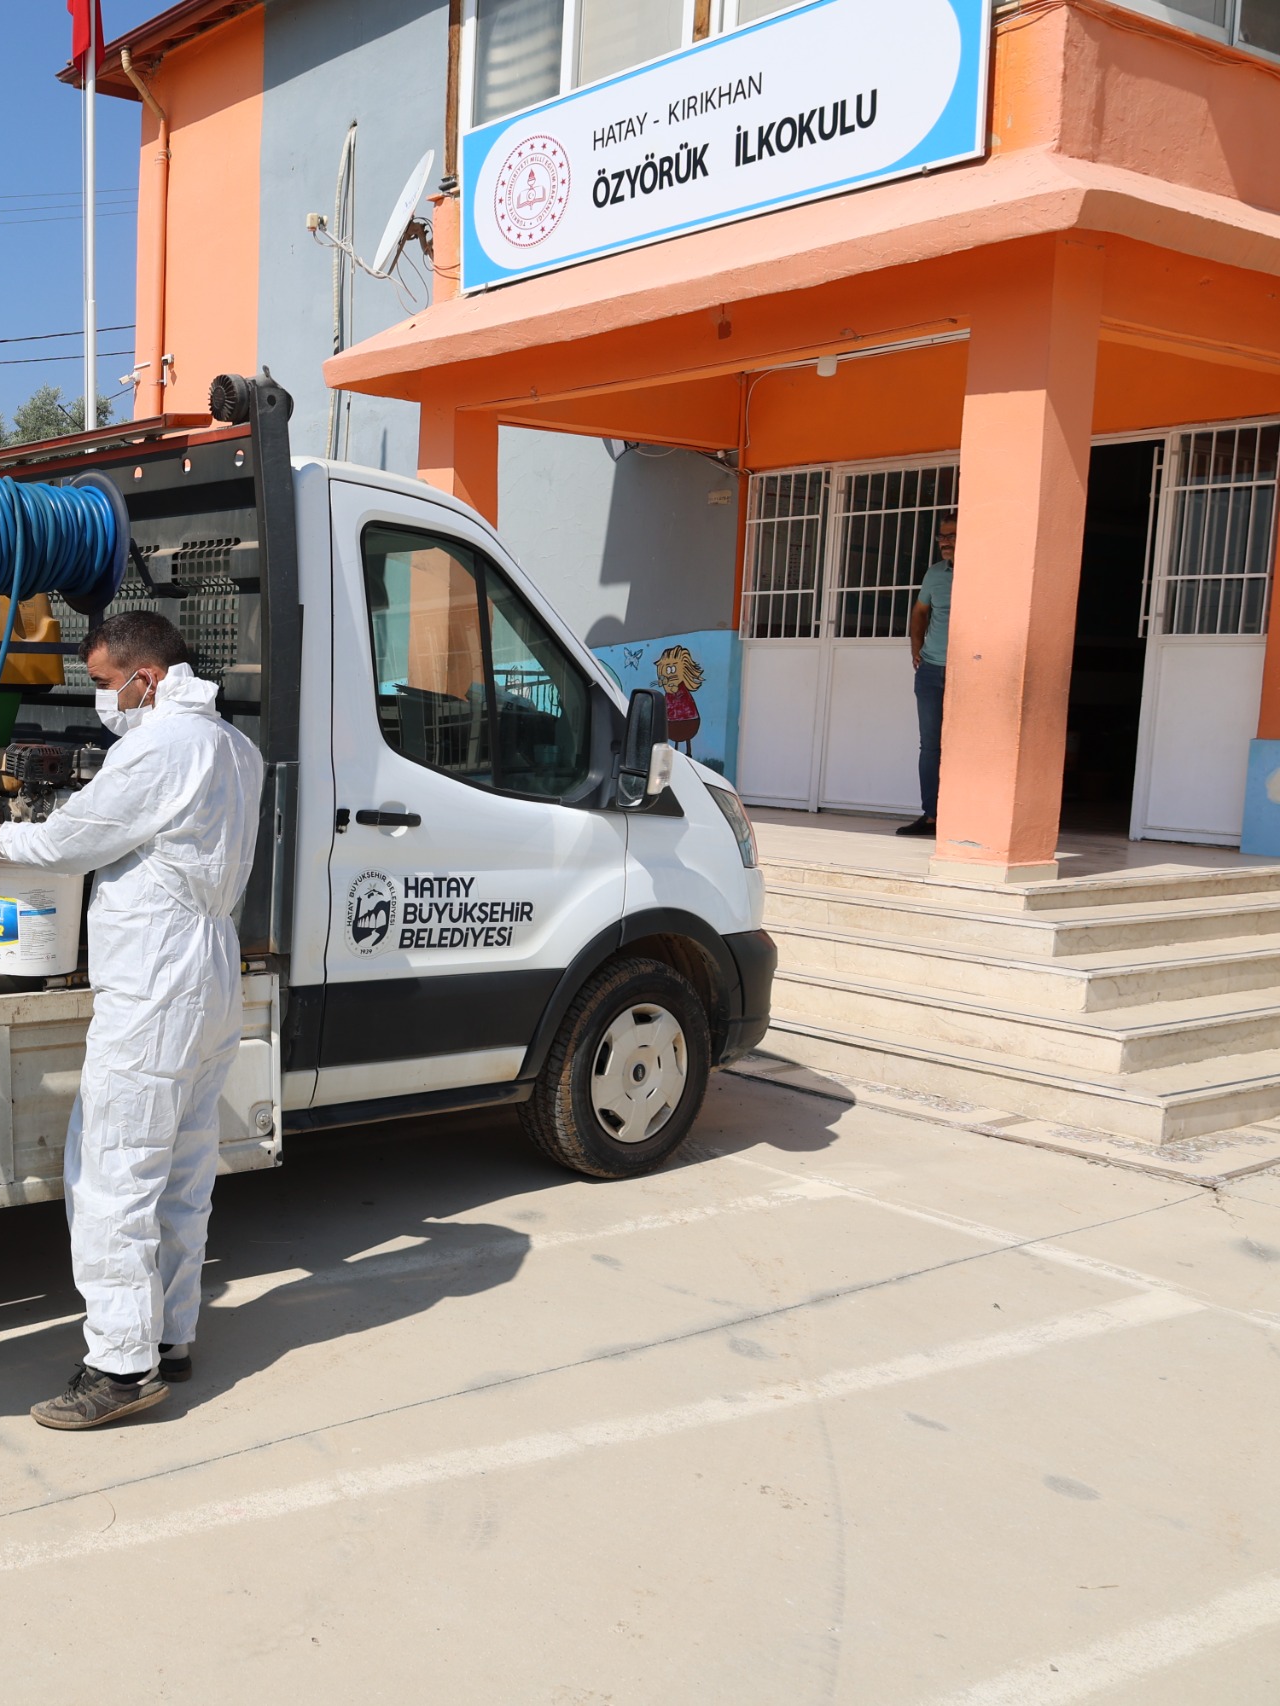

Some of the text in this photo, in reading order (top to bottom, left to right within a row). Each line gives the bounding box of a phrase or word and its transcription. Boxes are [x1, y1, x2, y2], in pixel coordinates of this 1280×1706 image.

[592, 111, 648, 152] HATAY
[667, 71, 763, 126] KIRIKHAN
[592, 89, 878, 210] ÖZYÖRÜK İLKOKULU
[404, 877, 475, 898] HATAY
[402, 901, 534, 924] BÜYÜKŞEHİR
[398, 926, 513, 949] BELEDİYESİ
